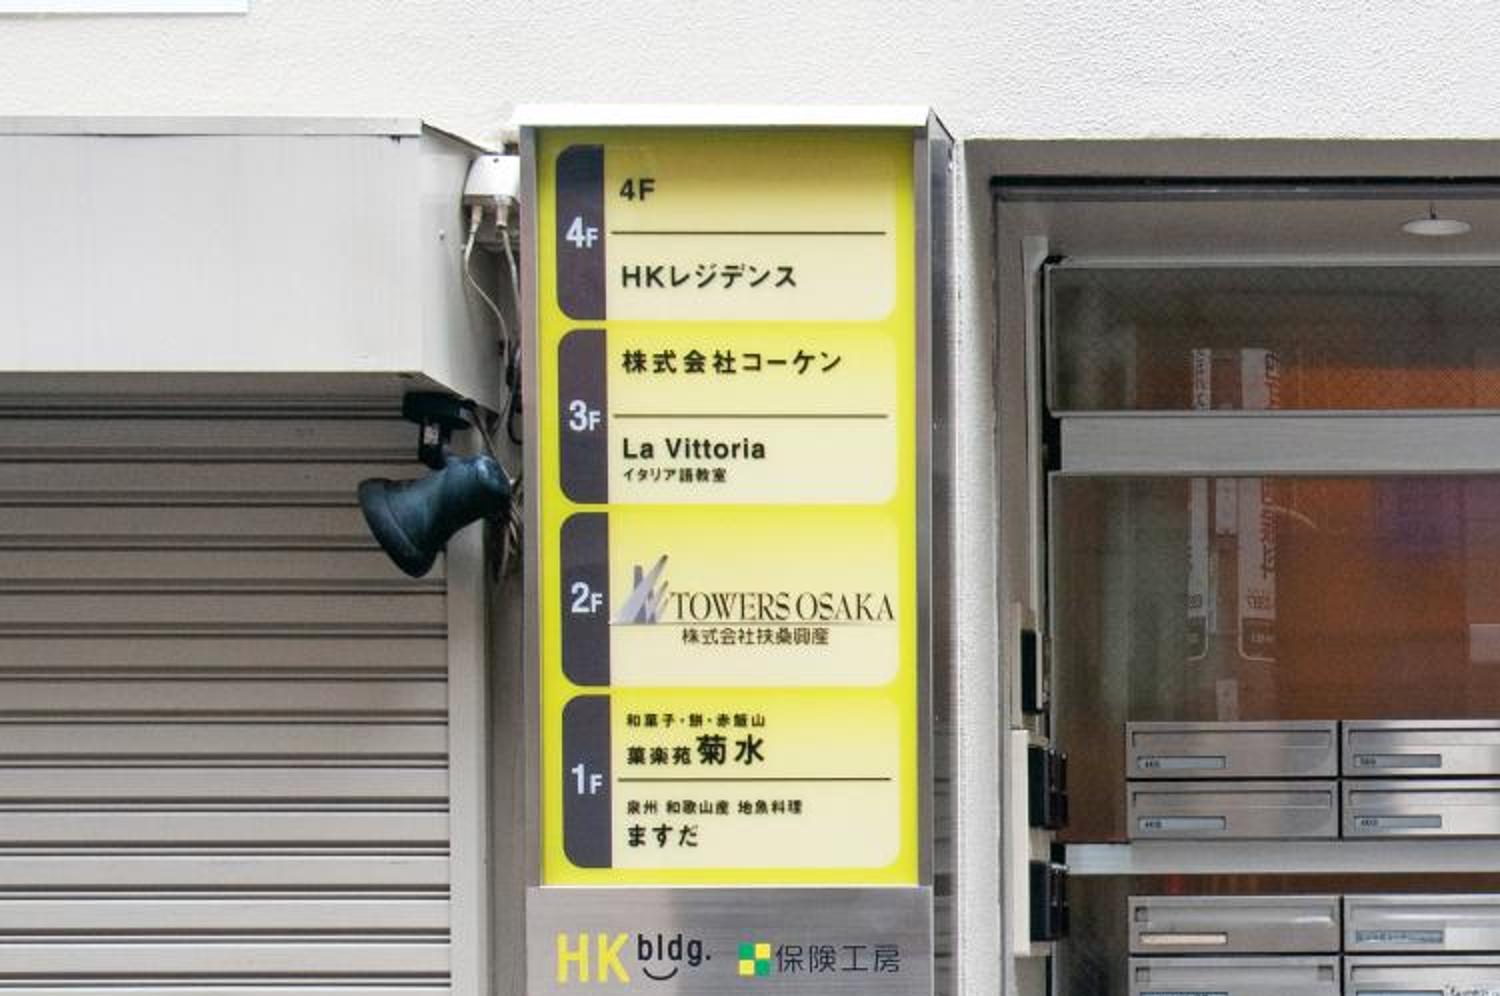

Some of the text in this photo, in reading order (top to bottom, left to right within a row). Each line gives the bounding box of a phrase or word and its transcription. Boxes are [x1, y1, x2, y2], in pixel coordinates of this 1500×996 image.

[619, 178, 656, 201] 4F
[565, 216, 599, 248] 4F
[621, 263, 798, 289] HKレジデンス
[622, 349, 842, 375] 株式会社コーケン
[568, 400, 601, 432] 3F
[622, 437, 766, 460] La Vittoria
[622, 466, 728, 483] イタリア語教室
[570, 582, 603, 614] 2F
[670, 591, 896, 621] TOWERS OSAKA
[571, 763, 603, 795] 1F
[627, 823, 699, 848] ますだ
[555, 932, 712, 983] HK bldg.
[775, 943, 901, 973] 保険工房
